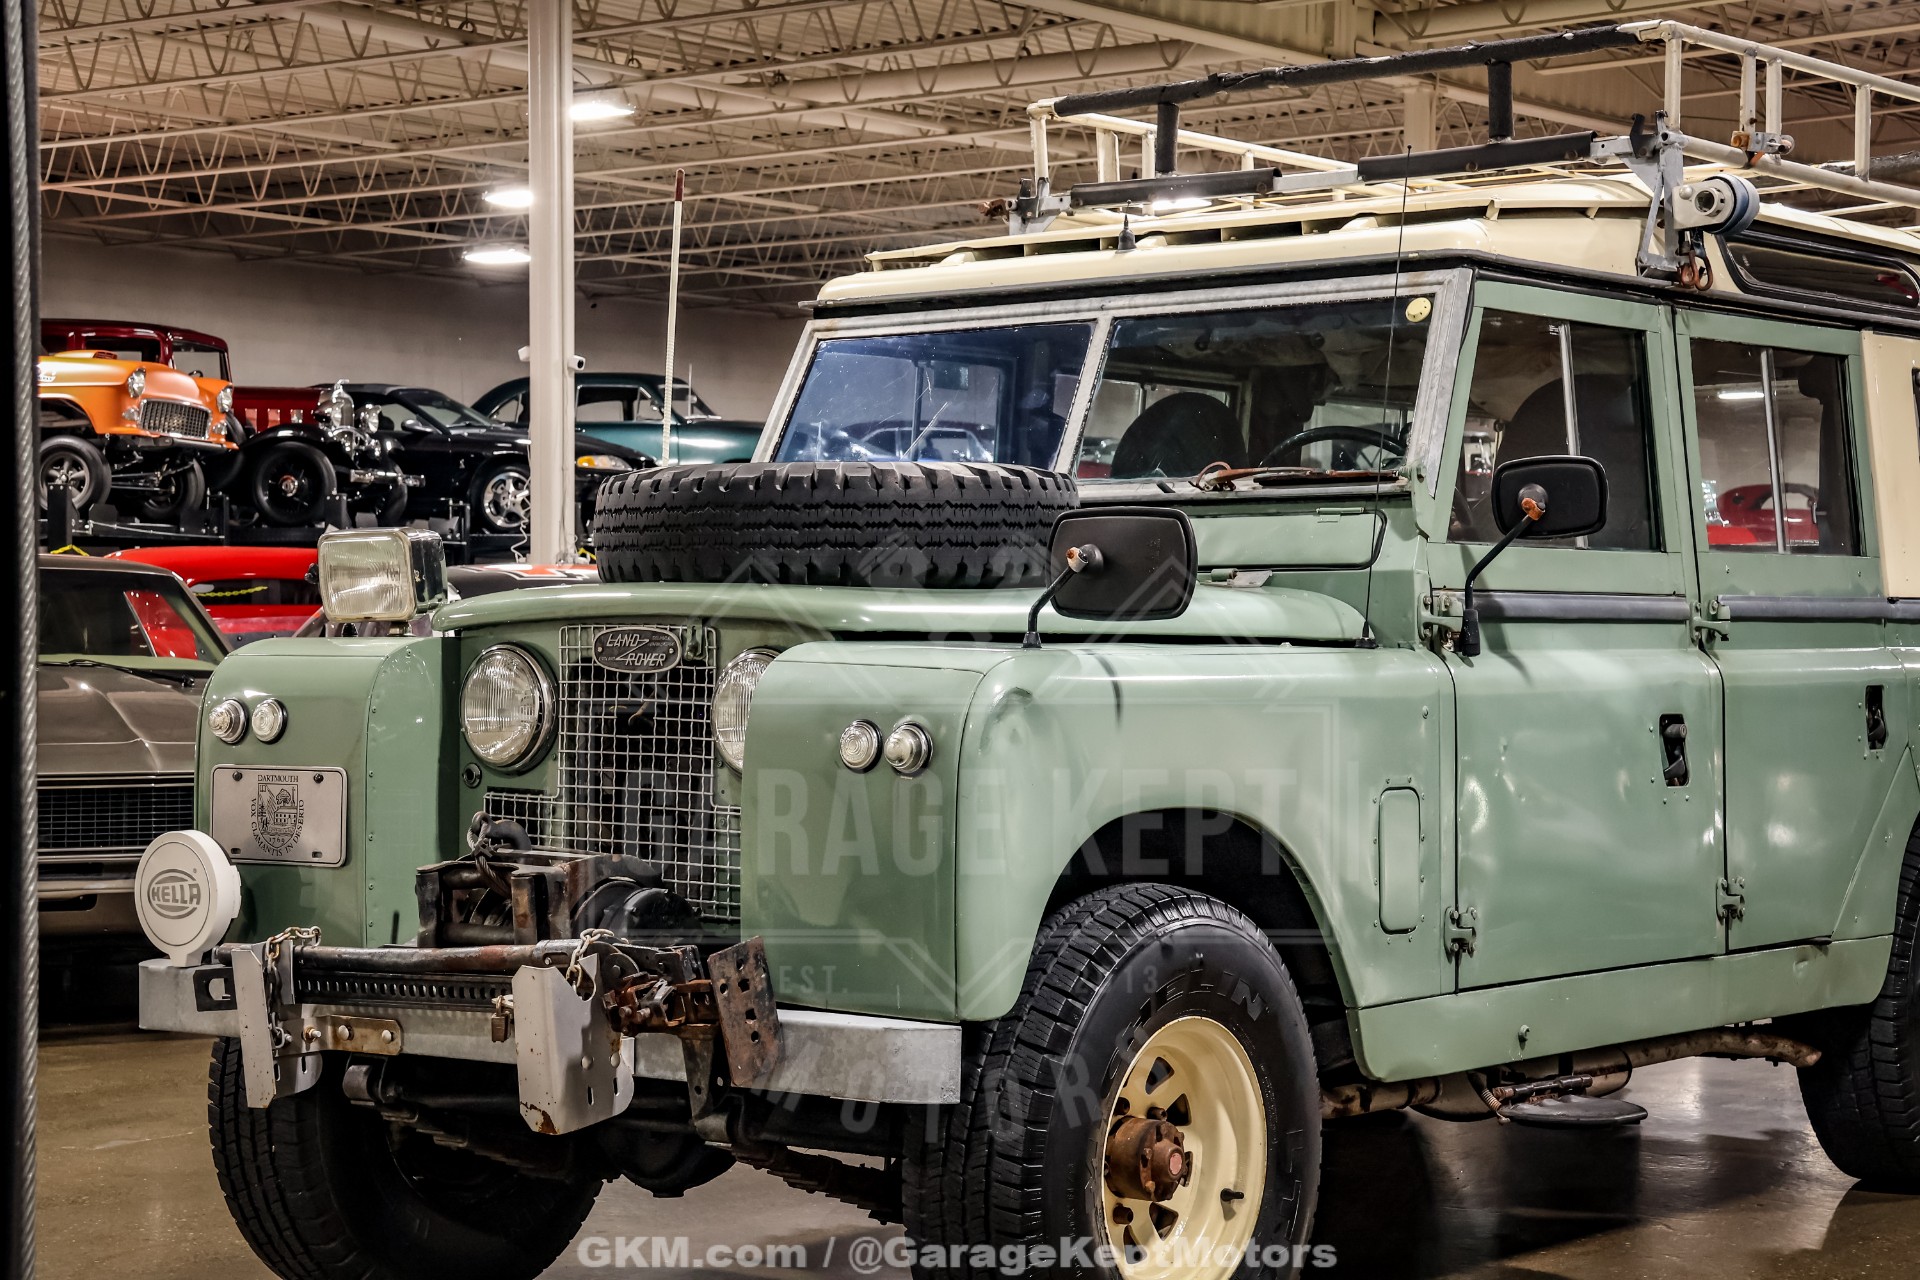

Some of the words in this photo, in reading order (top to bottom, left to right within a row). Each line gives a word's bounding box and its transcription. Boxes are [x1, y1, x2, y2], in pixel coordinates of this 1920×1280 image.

[606, 633, 640, 647] LAND
[625, 652, 666, 667] ROVER
[284, 842, 294, 854] IN
[151, 883, 201, 906] HELLA
